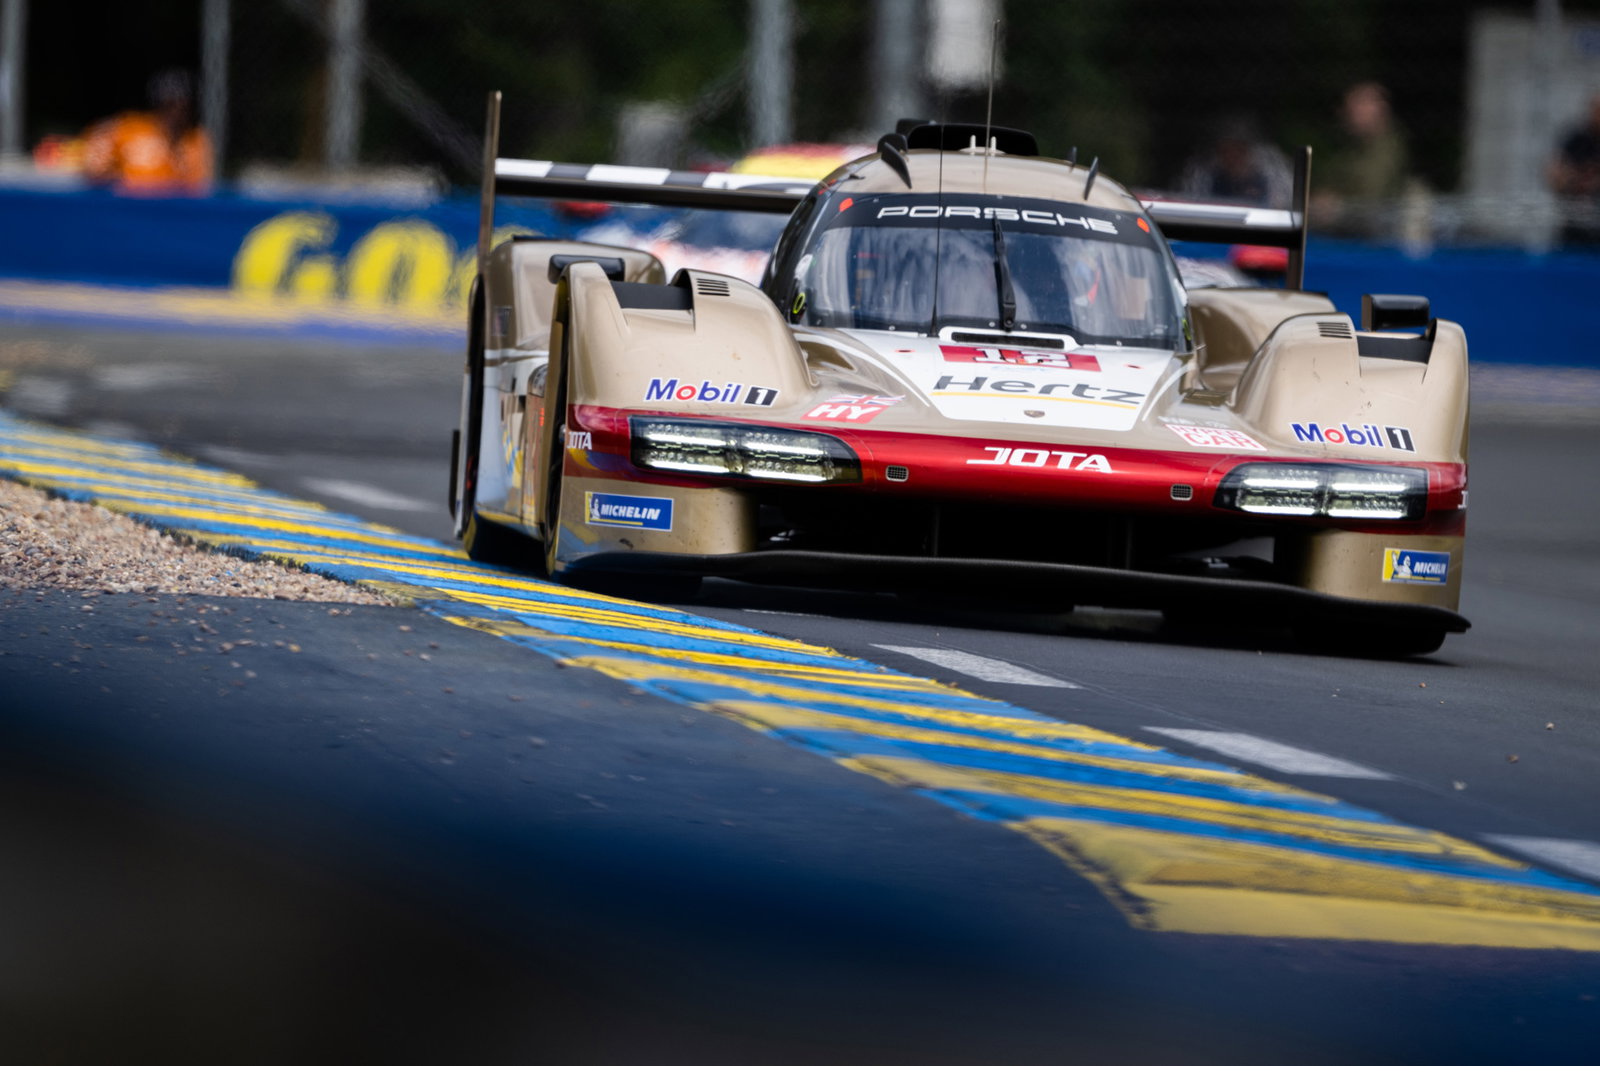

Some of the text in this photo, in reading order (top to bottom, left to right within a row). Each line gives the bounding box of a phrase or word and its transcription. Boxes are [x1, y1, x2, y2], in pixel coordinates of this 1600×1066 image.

[877, 206, 1118, 234] PORSCHE
[646, 379, 741, 402] Mobil
[933, 375, 1145, 404] Hertz
[807, 404, 881, 419] HY
[566, 431, 592, 450] JOTA
[1184, 433, 1260, 448] CAR
[1292, 423, 1412, 450] Mobil 1
[966, 447, 1112, 474] JOTA
[601, 504, 661, 520] MICHELIN
